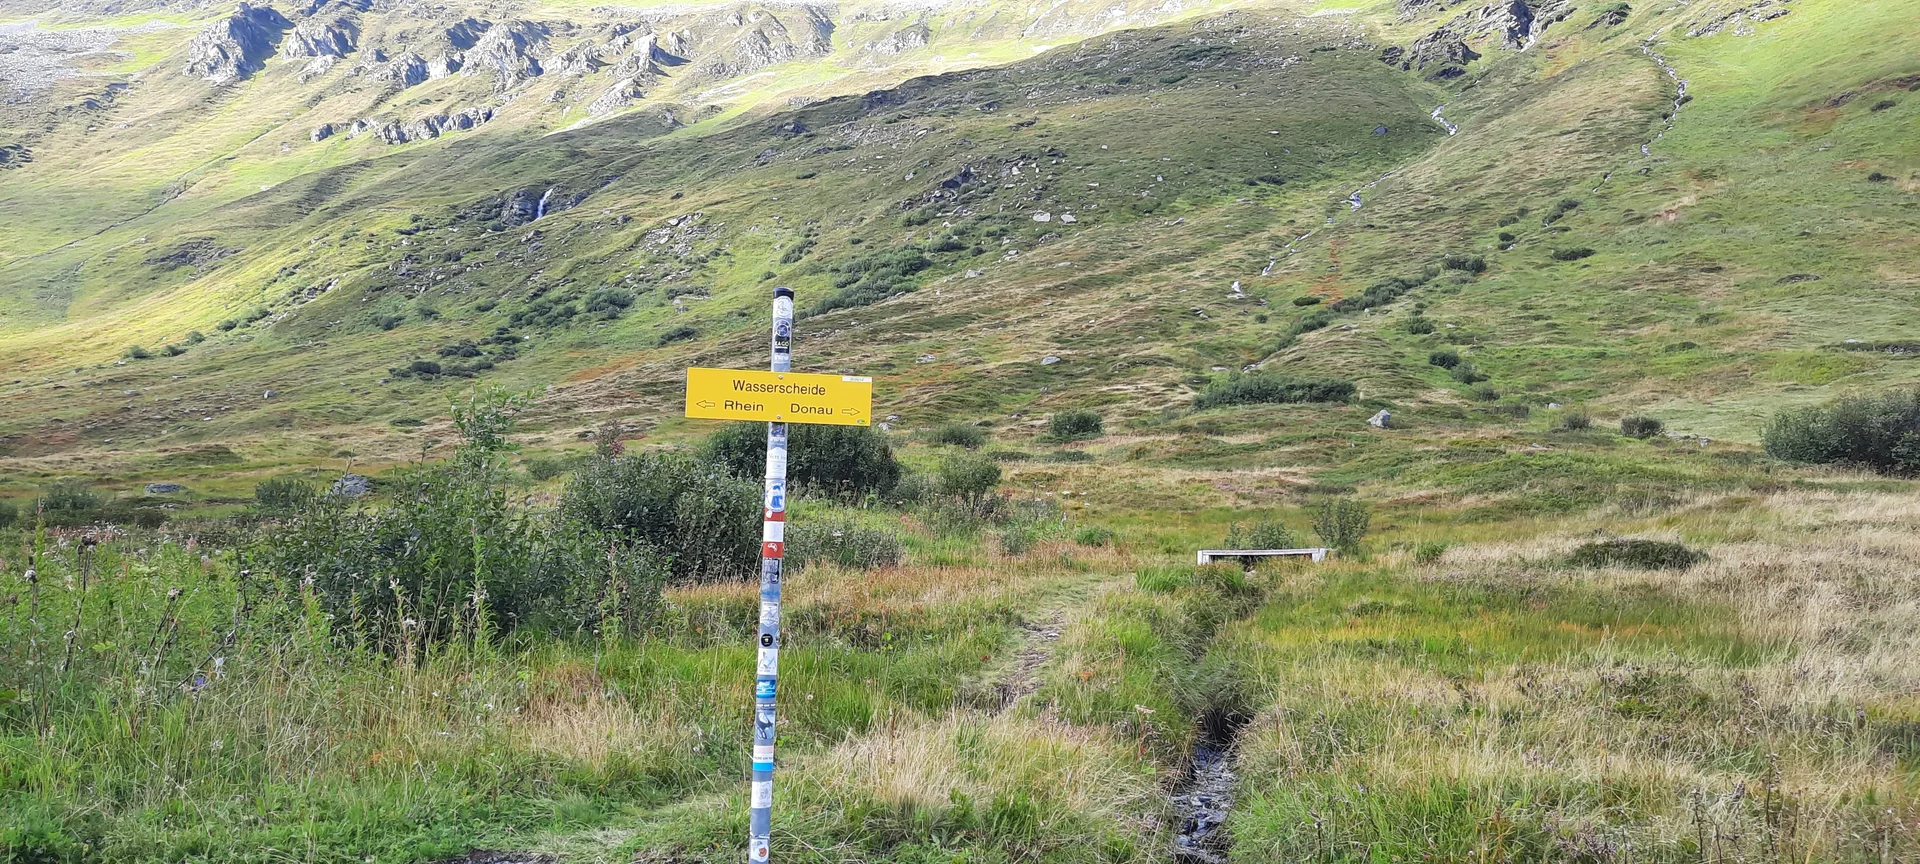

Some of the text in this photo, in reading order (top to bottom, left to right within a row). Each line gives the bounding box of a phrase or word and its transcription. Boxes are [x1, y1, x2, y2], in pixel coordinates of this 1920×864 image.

[732, 379, 826, 396] Wasserscheide
[724, 399, 833, 415] Rhein Donau
